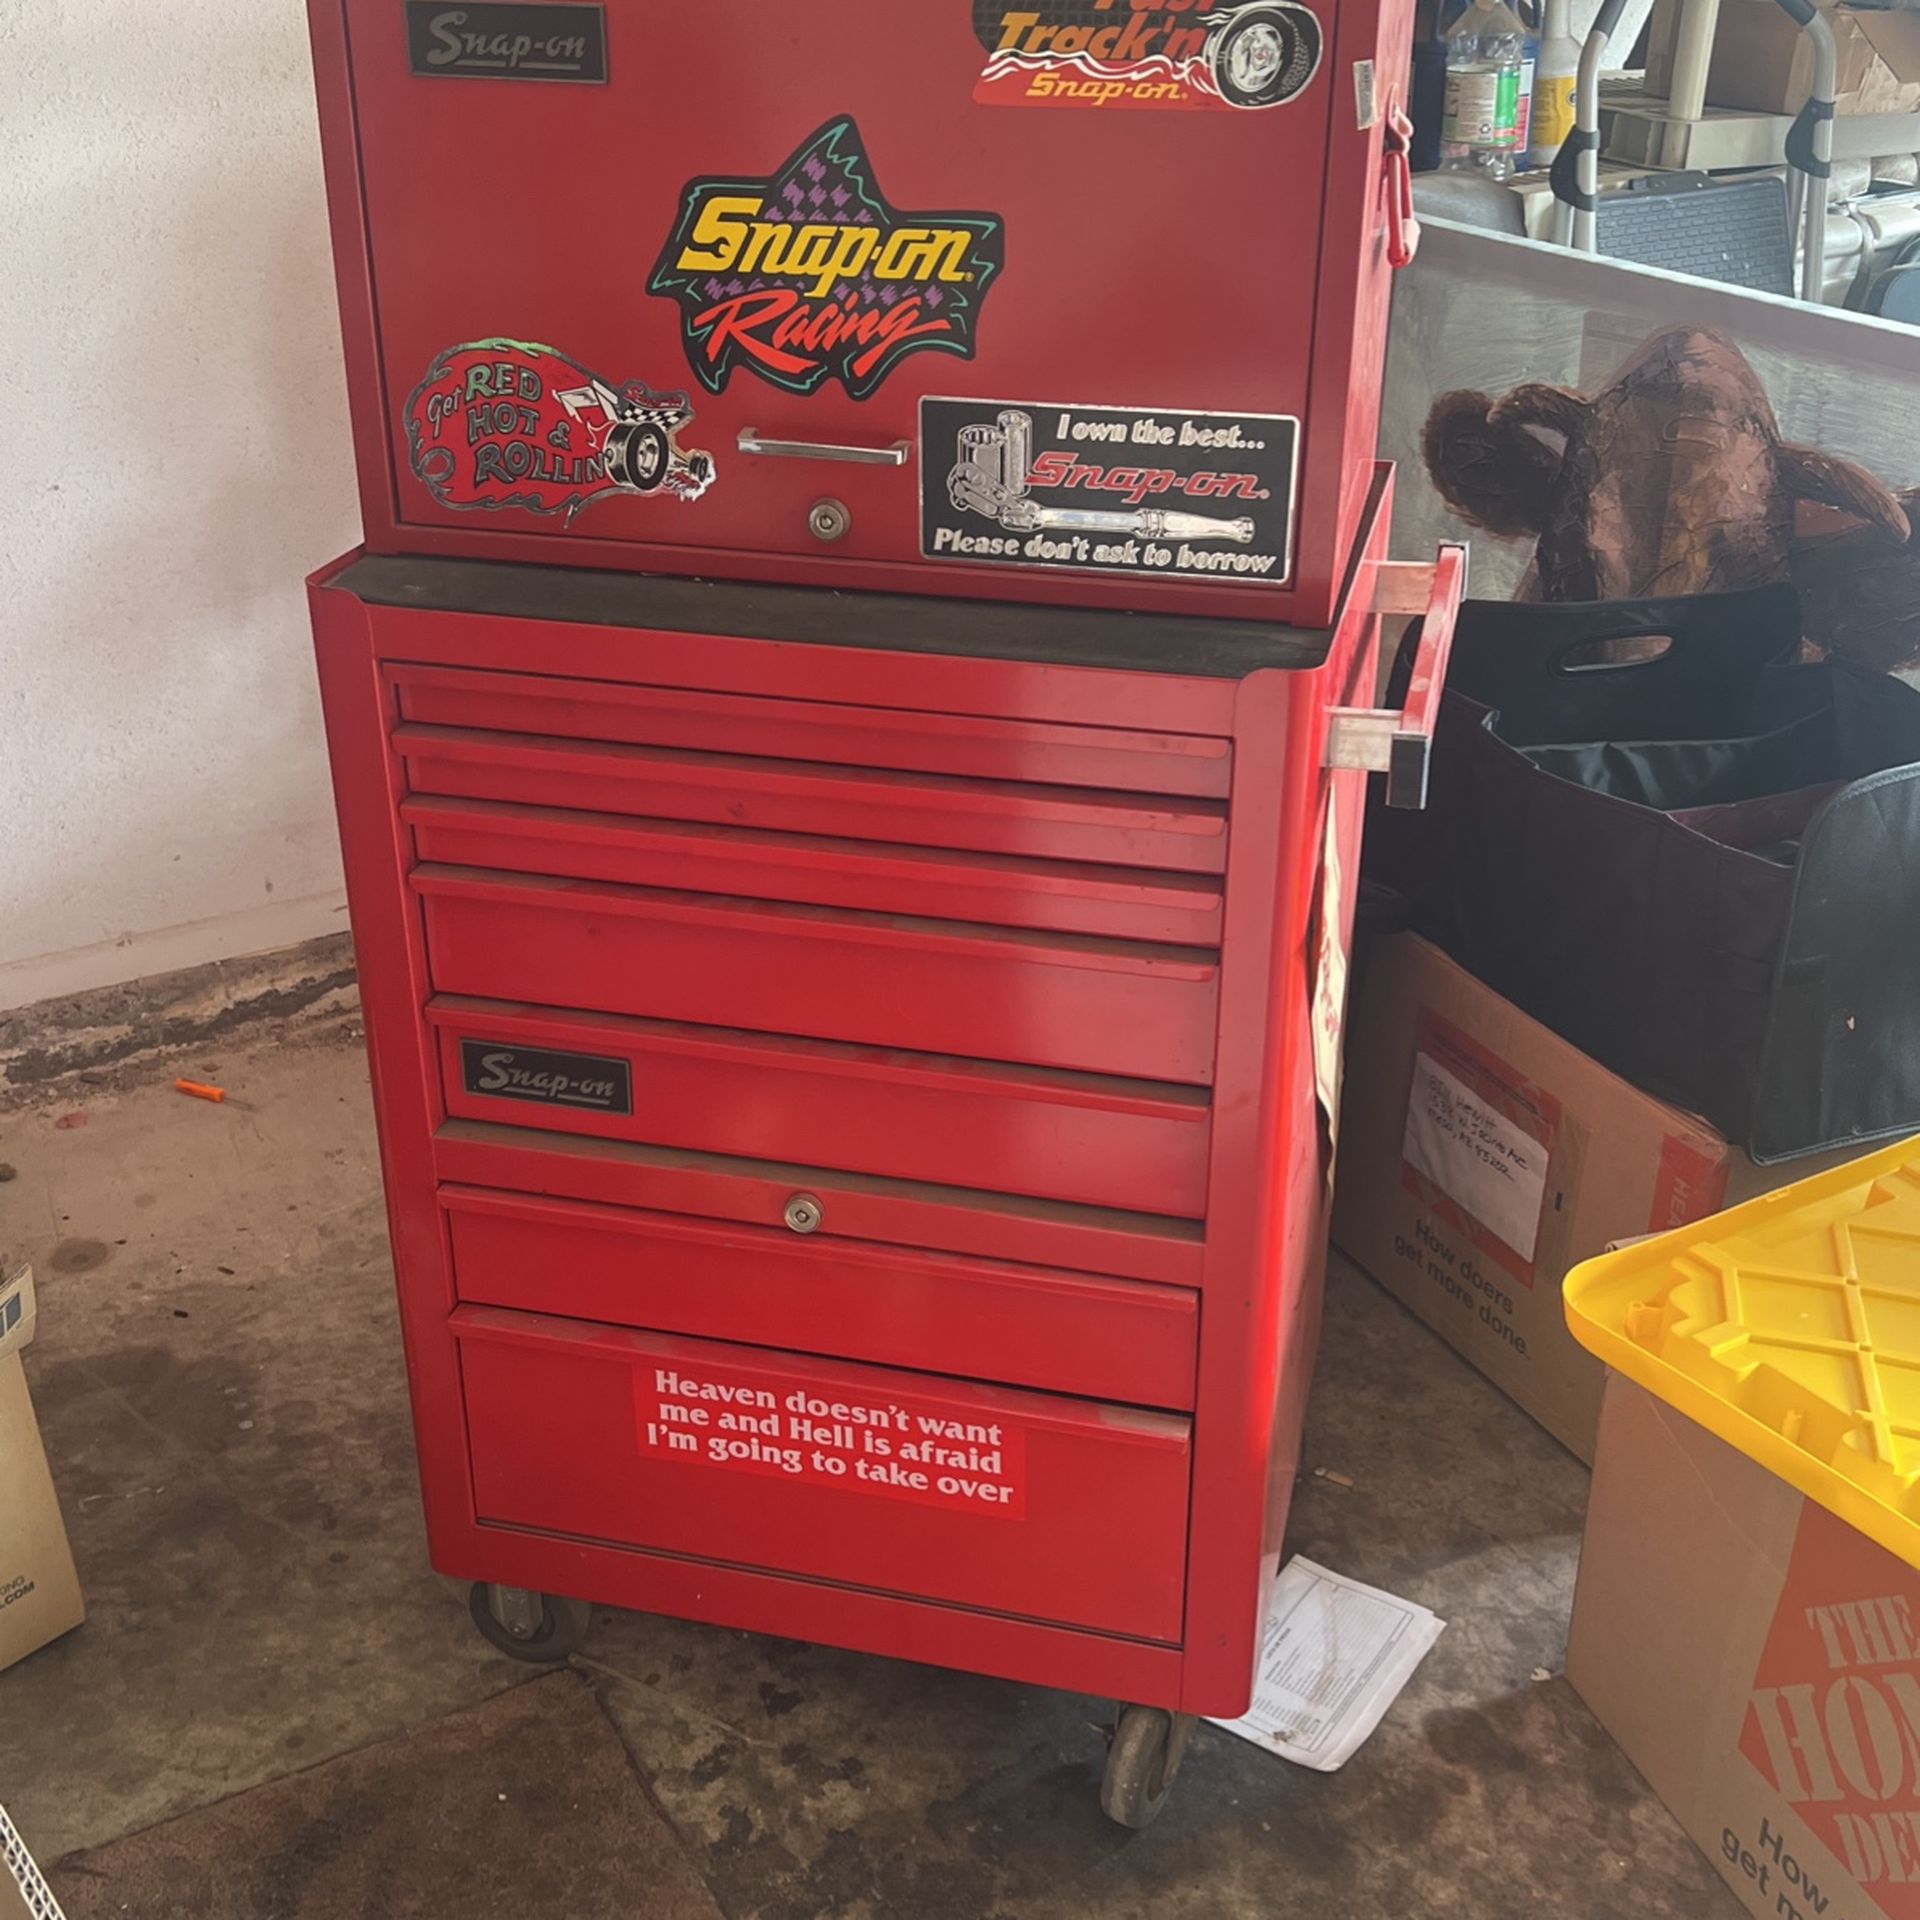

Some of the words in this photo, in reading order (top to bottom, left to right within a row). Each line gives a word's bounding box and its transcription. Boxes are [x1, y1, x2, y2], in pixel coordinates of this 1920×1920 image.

[426, 11, 586, 68] Snap-on
[996, 12, 1206, 60] Track'n
[1025, 72, 1181, 106] Snap-on
[676, 196, 972, 298] Snap-on
[694, 288, 952, 377] Racing
[464, 362, 542, 403] RED
[467, 403, 540, 443] HOT
[547, 421, 573, 451] &
[1057, 414, 1071, 440] I
[1072, 421, 1127, 443] own
[1131, 418, 1176, 446] the
[1178, 419, 1266, 450] best...
[1024, 451, 1260, 504] Snap-on
[933, 527, 1020, 556] Please
[1024, 533, 1089, 563] don't
[1092, 539, 1140, 566] ask
[1142, 543, 1173, 568] to
[1176, 544, 1278, 574] borrow
[478, 1053, 615, 1098] Snap-on
[1394, 1235, 1423, 1269] get
[1427, 1262, 1473, 1310] more
[1479, 1305, 1531, 1360] done.
[1416, 1219, 1456, 1264] How
[1460, 1261, 1513, 1315] doers
[655, 1369, 777, 1409] Heaven
[785, 1391, 910, 1431] doesn't
[917, 1415, 1003, 1446] want
[659, 1403, 710, 1426] me
[718, 1411, 781, 1437] and
[789, 1418, 855, 1450] Hell
[863, 1430, 892, 1456] is
[899, 1440, 1002, 1475] afraid
[647, 1422, 698, 1452] I'm
[708, 1437, 803, 1474] going
[811, 1450, 847, 1476] to
[855, 1457, 929, 1491] take
[936, 1473, 1014, 1504] over
[1804, 1594, 1920, 1669] THE
[1721, 1827, 1770, 1896] get
[1758, 1817, 1829, 1914] How
